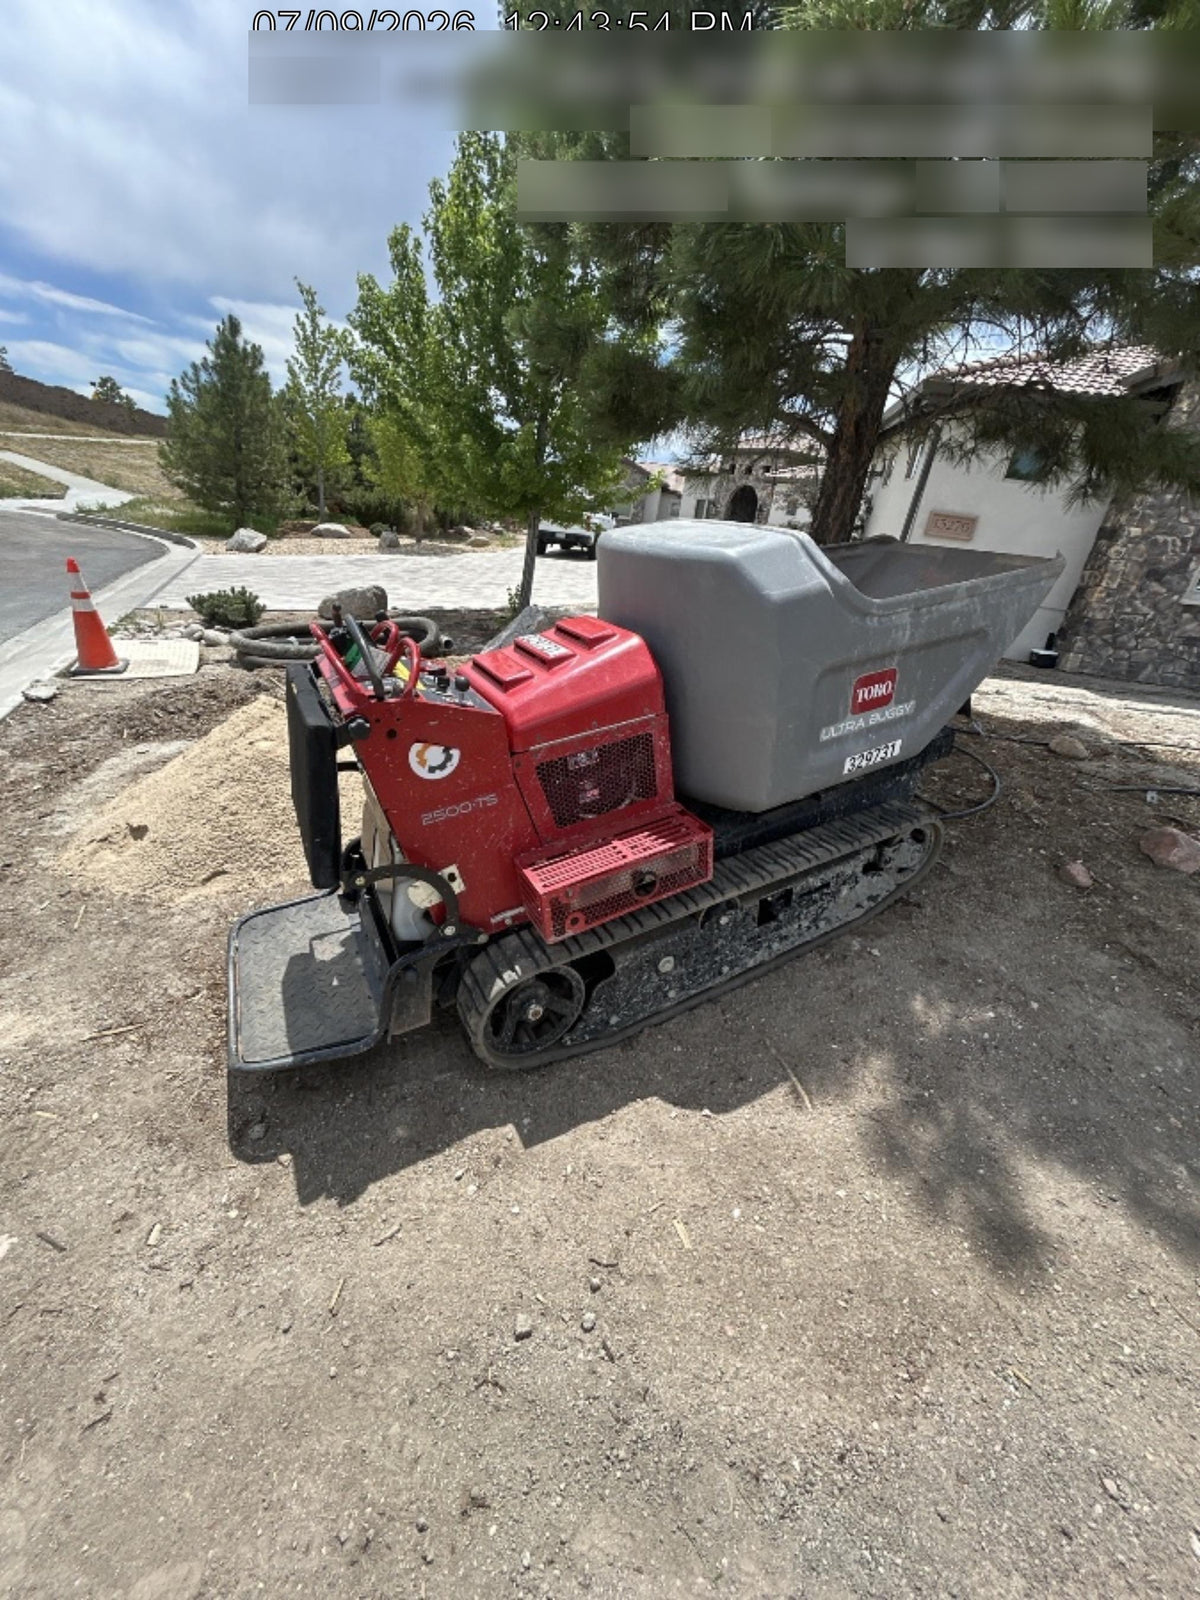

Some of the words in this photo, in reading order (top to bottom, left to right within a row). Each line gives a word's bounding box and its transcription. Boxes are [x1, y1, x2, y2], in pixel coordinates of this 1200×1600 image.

[857, 680, 893, 703] TORO
[819, 718, 865, 742] ULTRA
[869, 702, 912, 725] BUGGY
[846, 743, 896, 770] 329731
